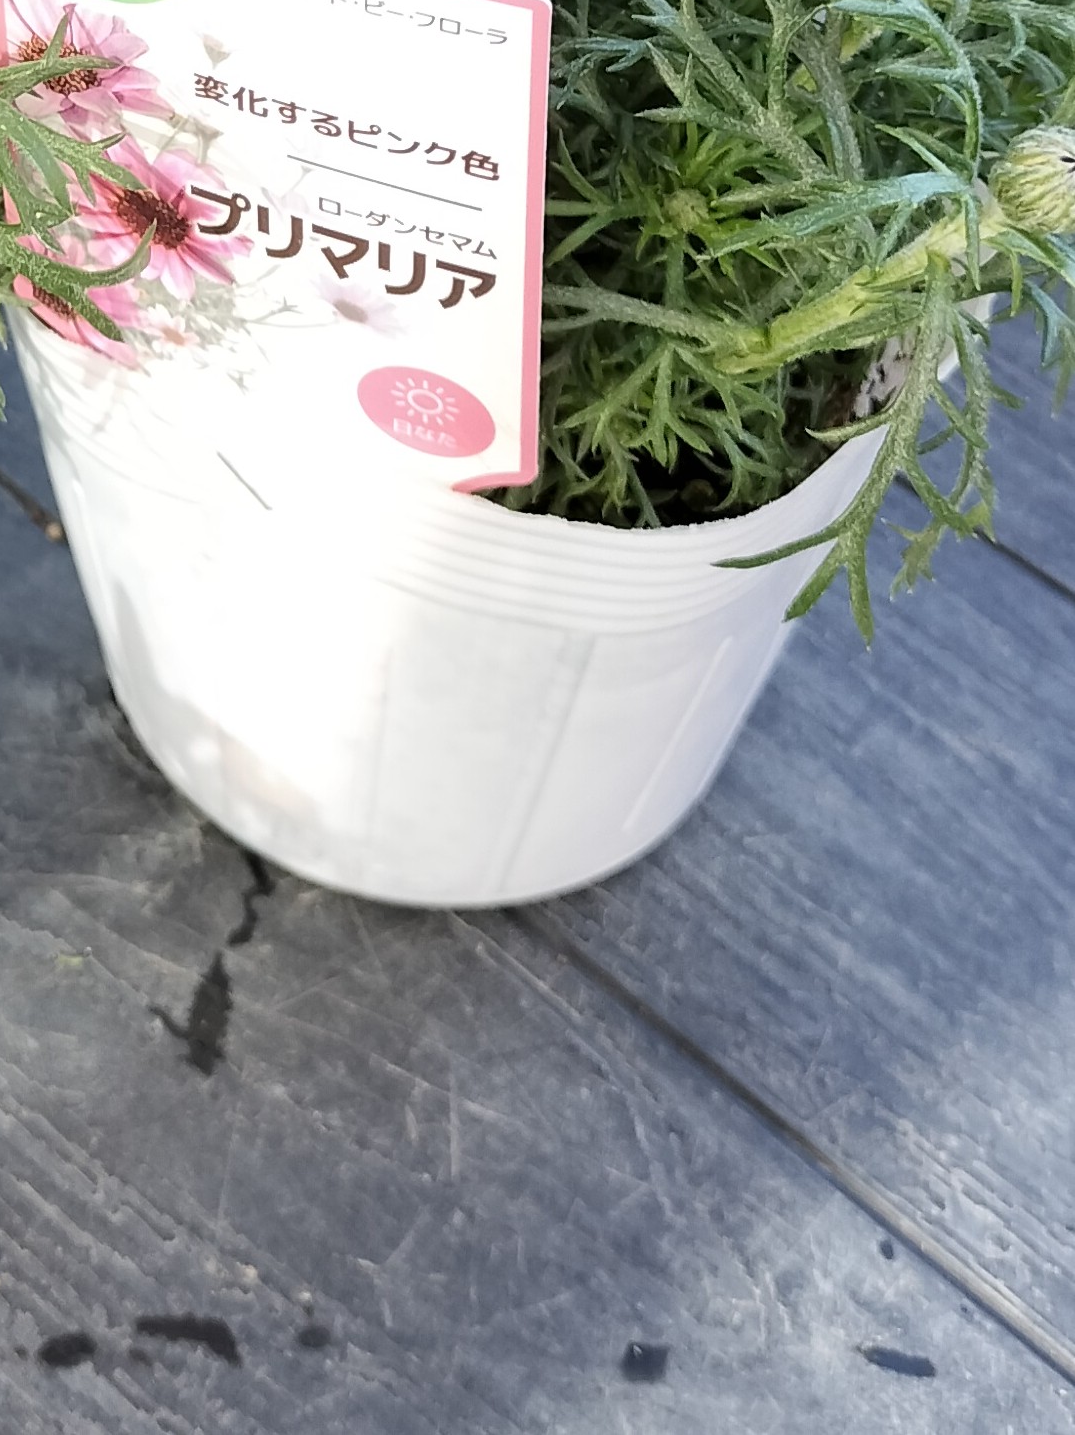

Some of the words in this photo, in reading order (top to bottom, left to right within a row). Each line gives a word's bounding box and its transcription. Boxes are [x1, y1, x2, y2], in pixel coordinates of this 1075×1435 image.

[193, 72, 500, 181] 変化するピンク色
[190, 184, 497, 310] プリマリア
[318, 196, 498, 260] ローダンセマム
